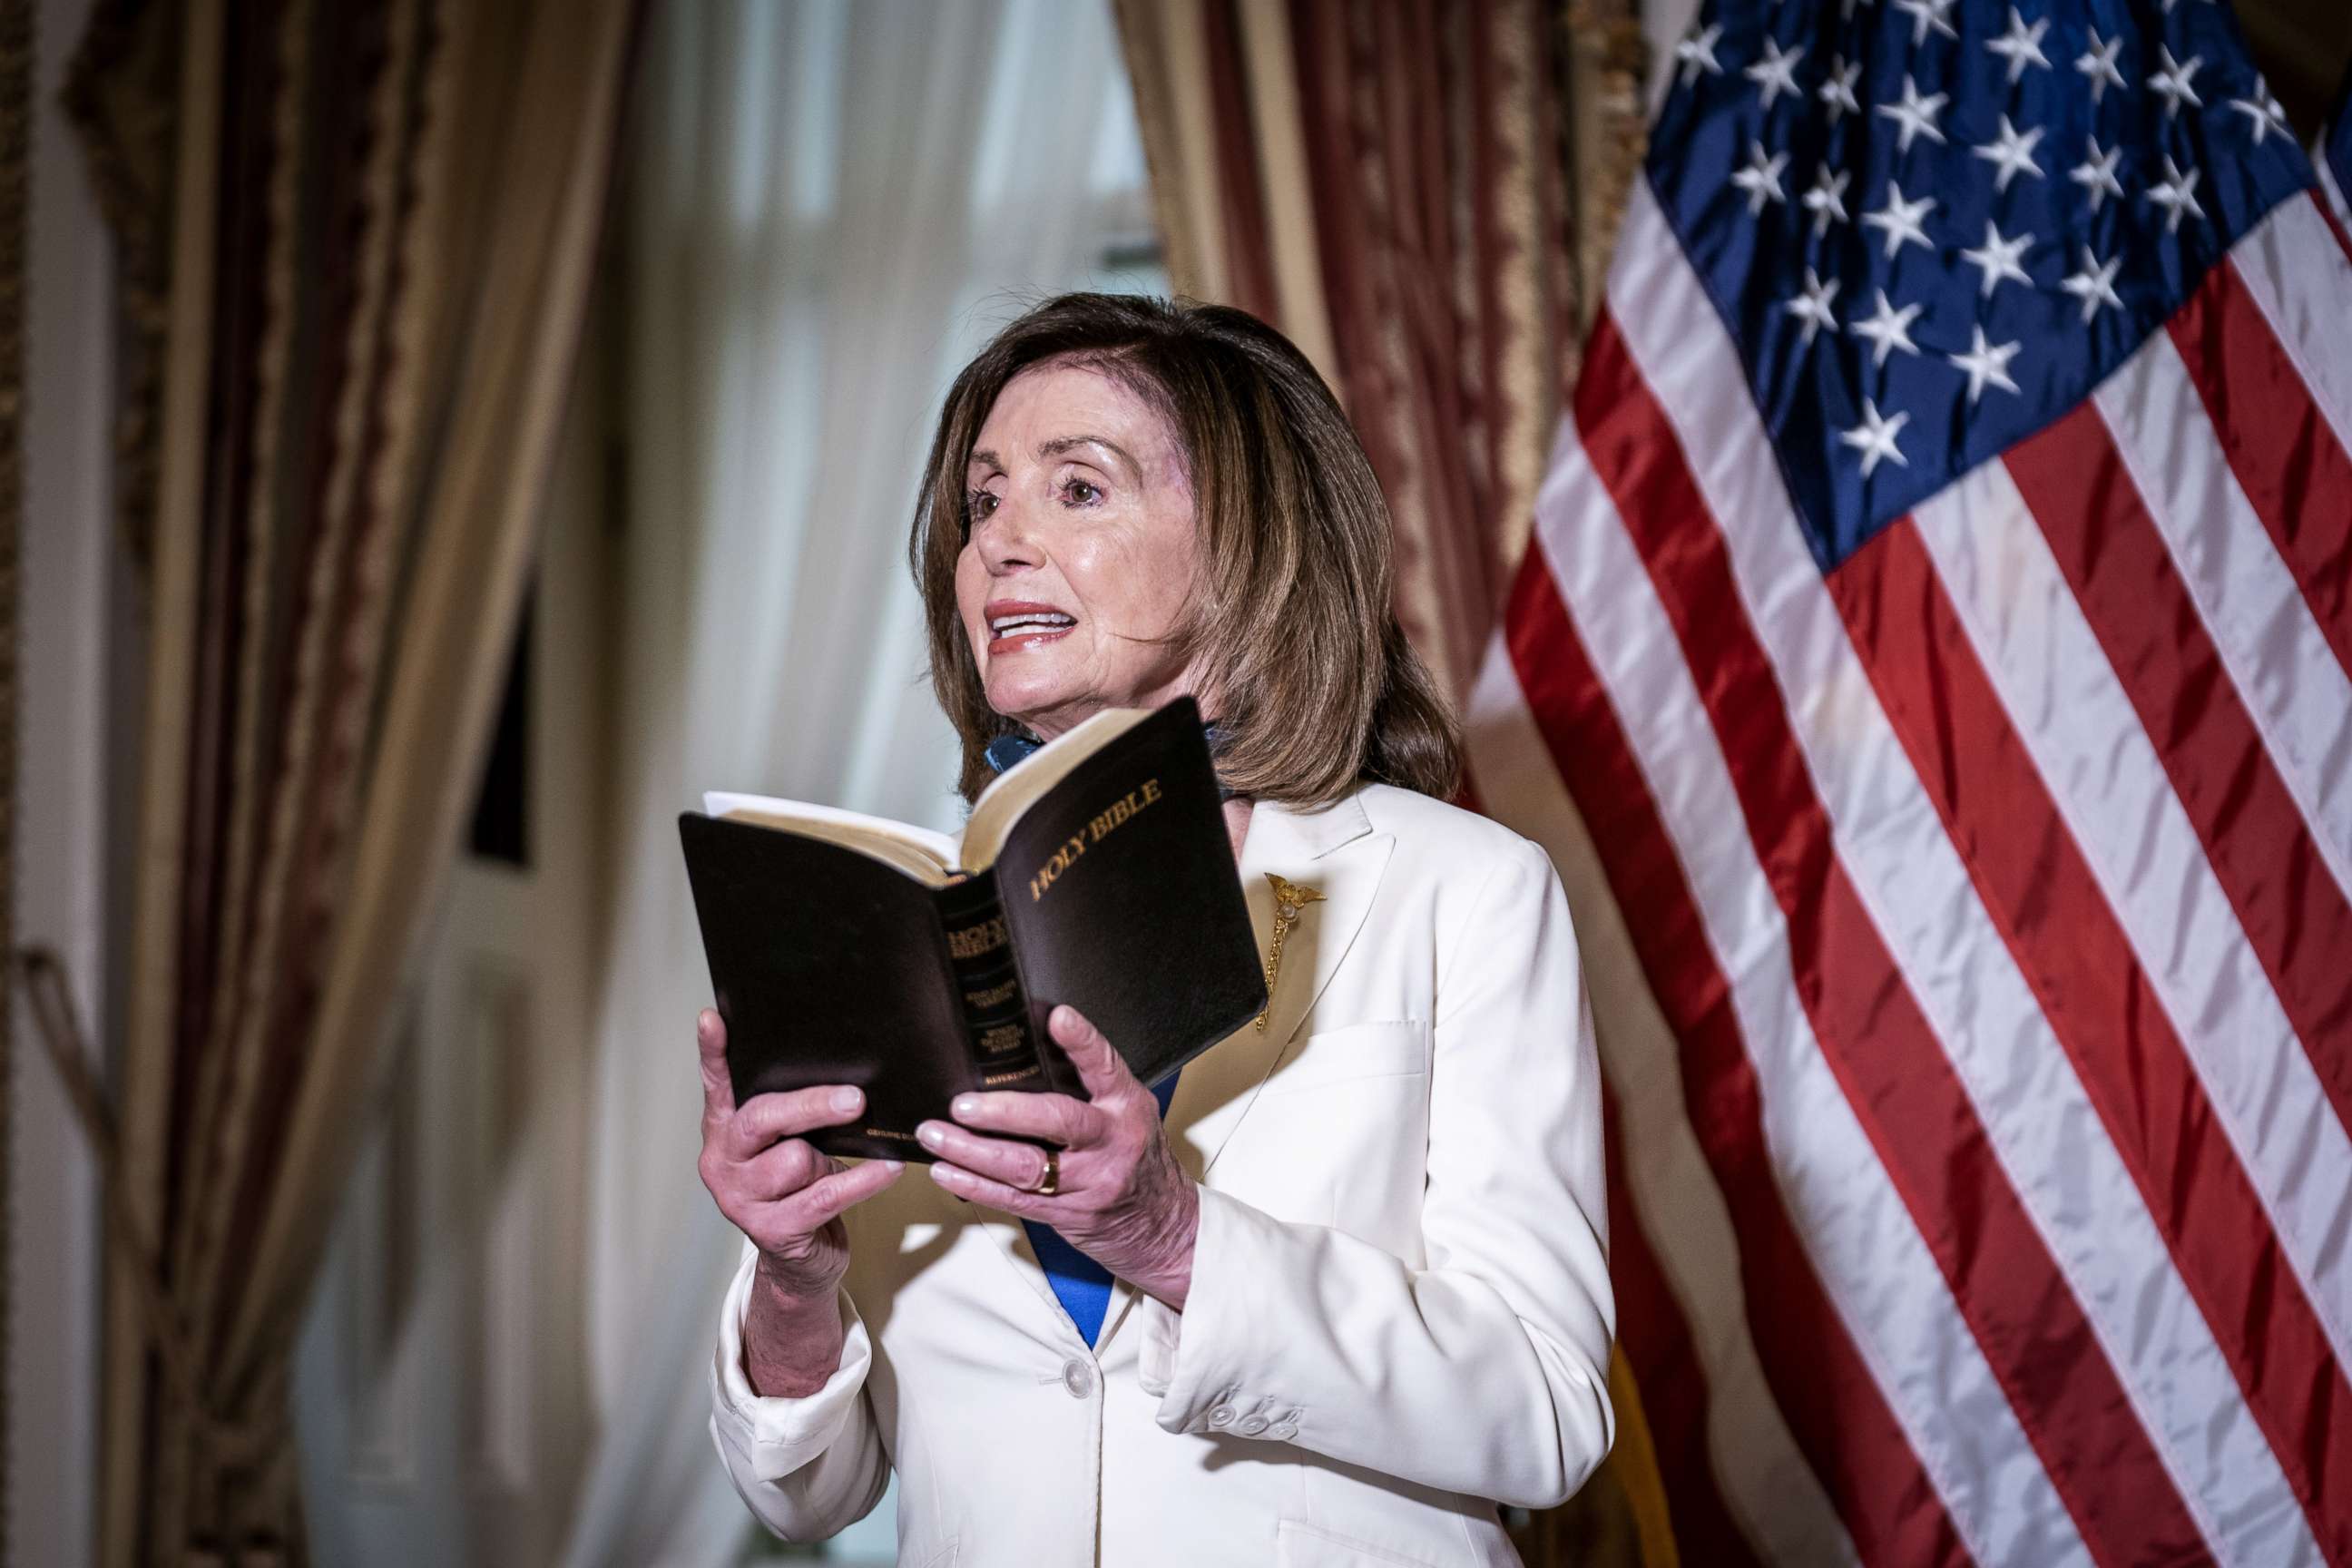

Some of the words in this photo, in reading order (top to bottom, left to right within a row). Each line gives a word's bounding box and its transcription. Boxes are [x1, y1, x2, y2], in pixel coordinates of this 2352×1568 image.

[1031, 828, 1086, 901] HOLY
[1089, 778, 1162, 842] BIBLE
[947, 917, 1004, 945] HOLY
